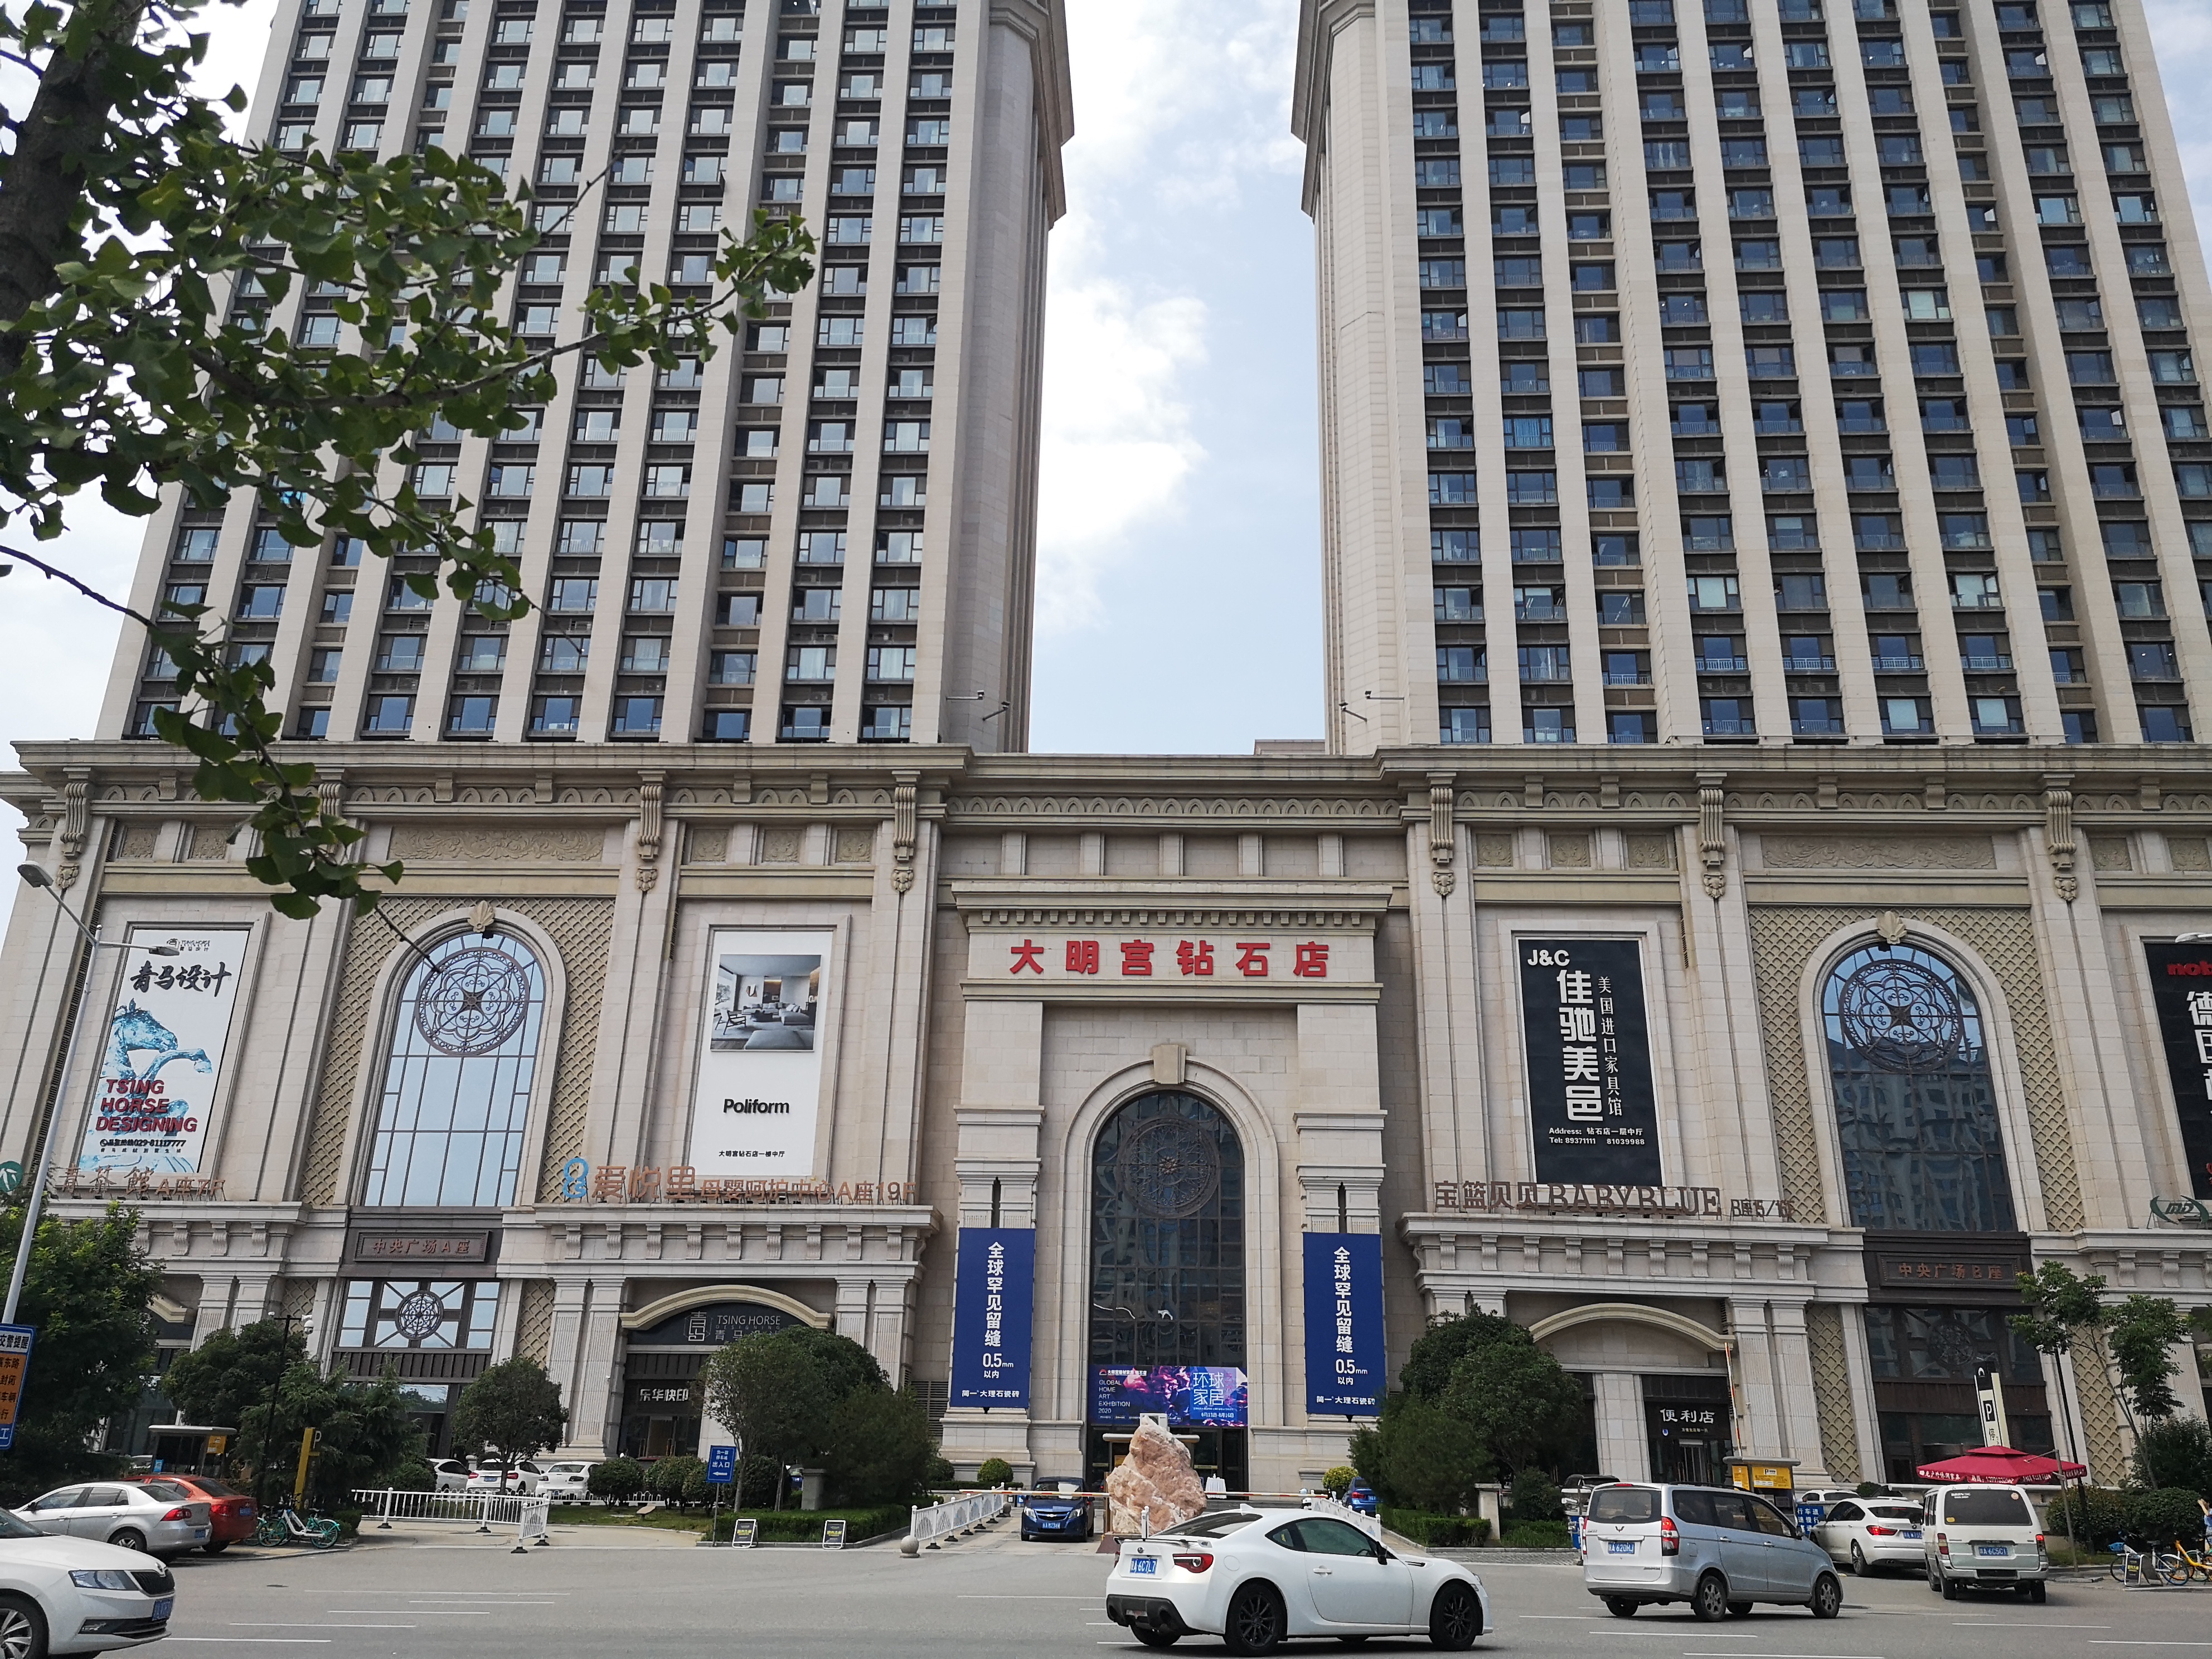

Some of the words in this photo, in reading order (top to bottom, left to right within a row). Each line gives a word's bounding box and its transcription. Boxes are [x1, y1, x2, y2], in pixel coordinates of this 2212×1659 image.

[1010, 939, 1329, 977] 大明宫钻石店
[1527, 949, 1570, 966] J&C
[130, 961, 232, 997] 青马设计
[1556, 969, 1603, 1121] 佳驰美邑
[1598, 976, 1622, 1116] 美国进口家具馆
[106, 1079, 164, 1094] TSING
[100, 1097, 169, 1113] HORSE
[723, 1099, 789, 1114] Poliform
[95, 1116, 198, 1132] DESIGNING
[1587, 1127, 1643, 1136] 钻石店一层中厅
[1435, 1181, 1538, 1210] 宝篮贝贝
[1548, 1183, 1721, 1216] BABYBLUE
[373, 1238, 470, 1253] 中央广场A座
[1899, 1263, 2003, 1279] 中央广场B座
[984, 1241, 1005, 1347] 全球罕见留缝
[1333, 1246, 1353, 1353] 全球罕见留缝
[717, 1315, 746, 1325] TSING
[748, 1316, 780, 1325] HORSE
[1193, 1372, 1224, 1388] 环球
[1337, 1376, 1354, 1385] 以内
[1194, 1389, 1224, 1405] 家居
[1660, 1408, 1715, 1424] 便利店
[1986, 1404, 1992, 1420] P
[313, 1430, 322, 1449] P
